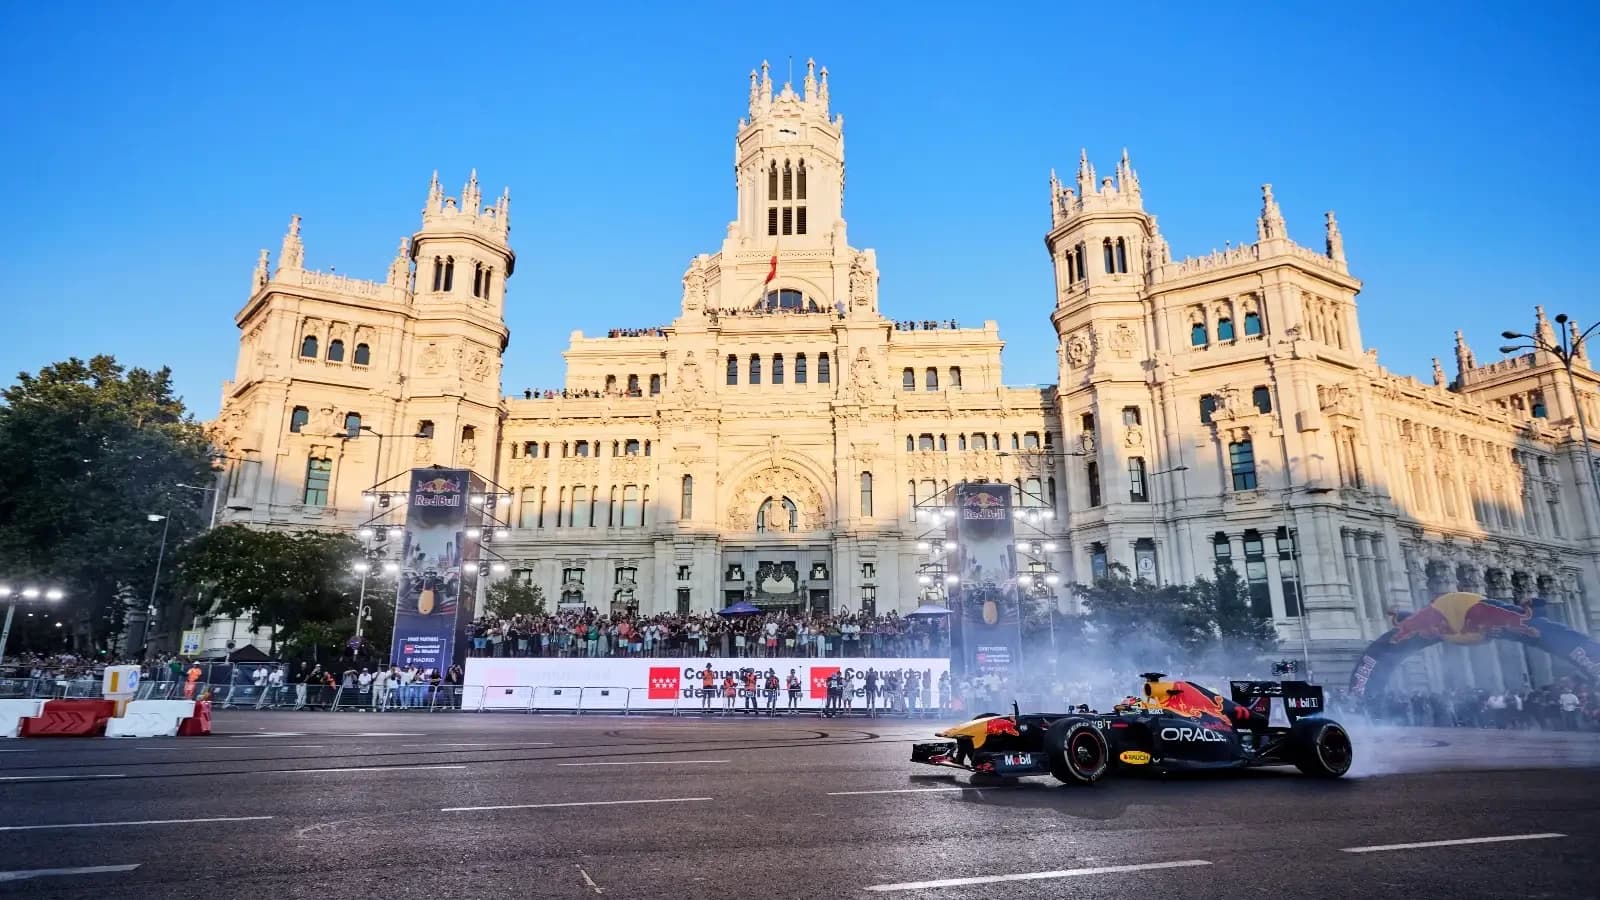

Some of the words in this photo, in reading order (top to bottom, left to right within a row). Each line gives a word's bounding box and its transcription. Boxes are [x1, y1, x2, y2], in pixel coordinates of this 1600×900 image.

[414, 494, 438, 506] Red
[439, 495, 460, 506] Bull
[1288, 698, 1310, 708] Mobil
[1004, 752, 1032, 766] Mobil
